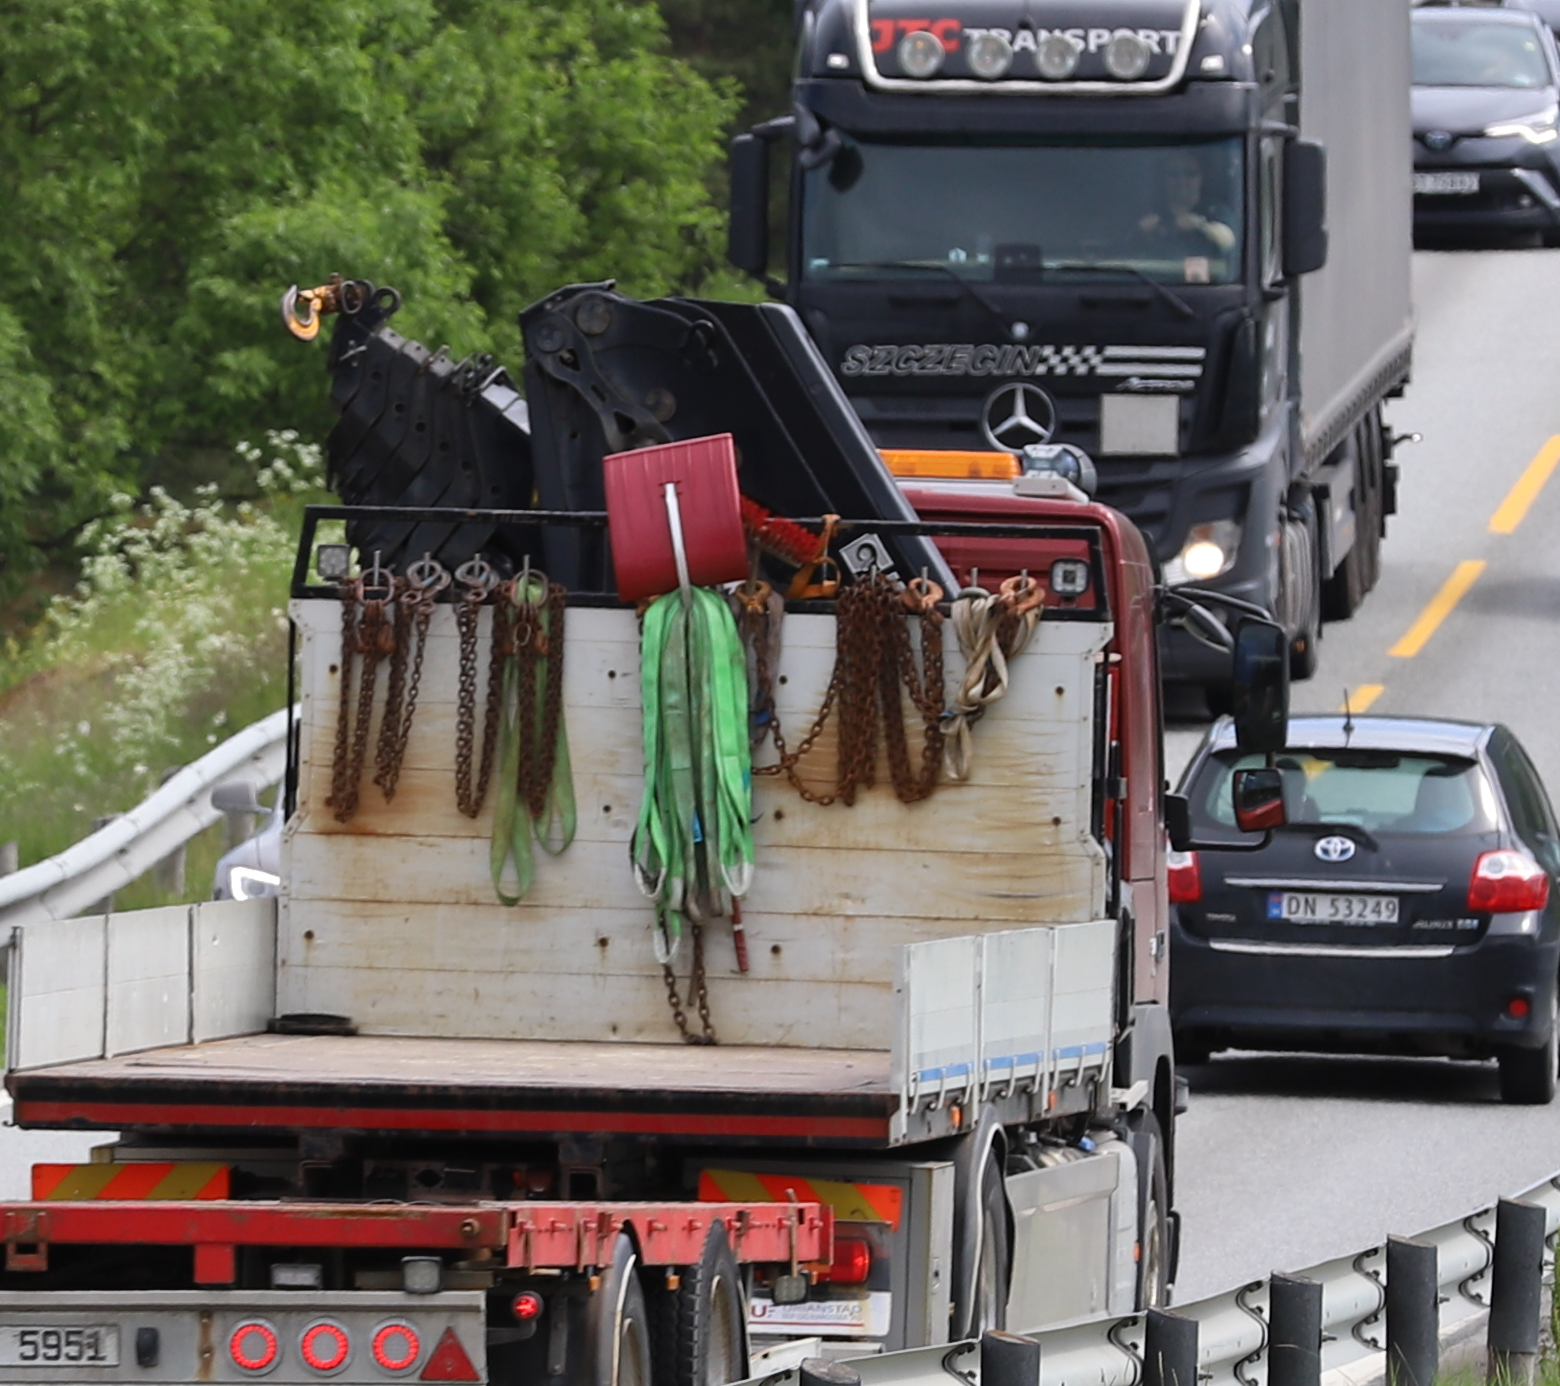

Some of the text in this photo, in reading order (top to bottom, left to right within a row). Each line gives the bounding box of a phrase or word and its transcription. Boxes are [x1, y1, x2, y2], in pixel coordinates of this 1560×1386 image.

[841, 343, 1041, 376] SZCZECIN
[1287, 895, 1398, 920] DN 53249
[20, 1330, 107, 1361] 5951
